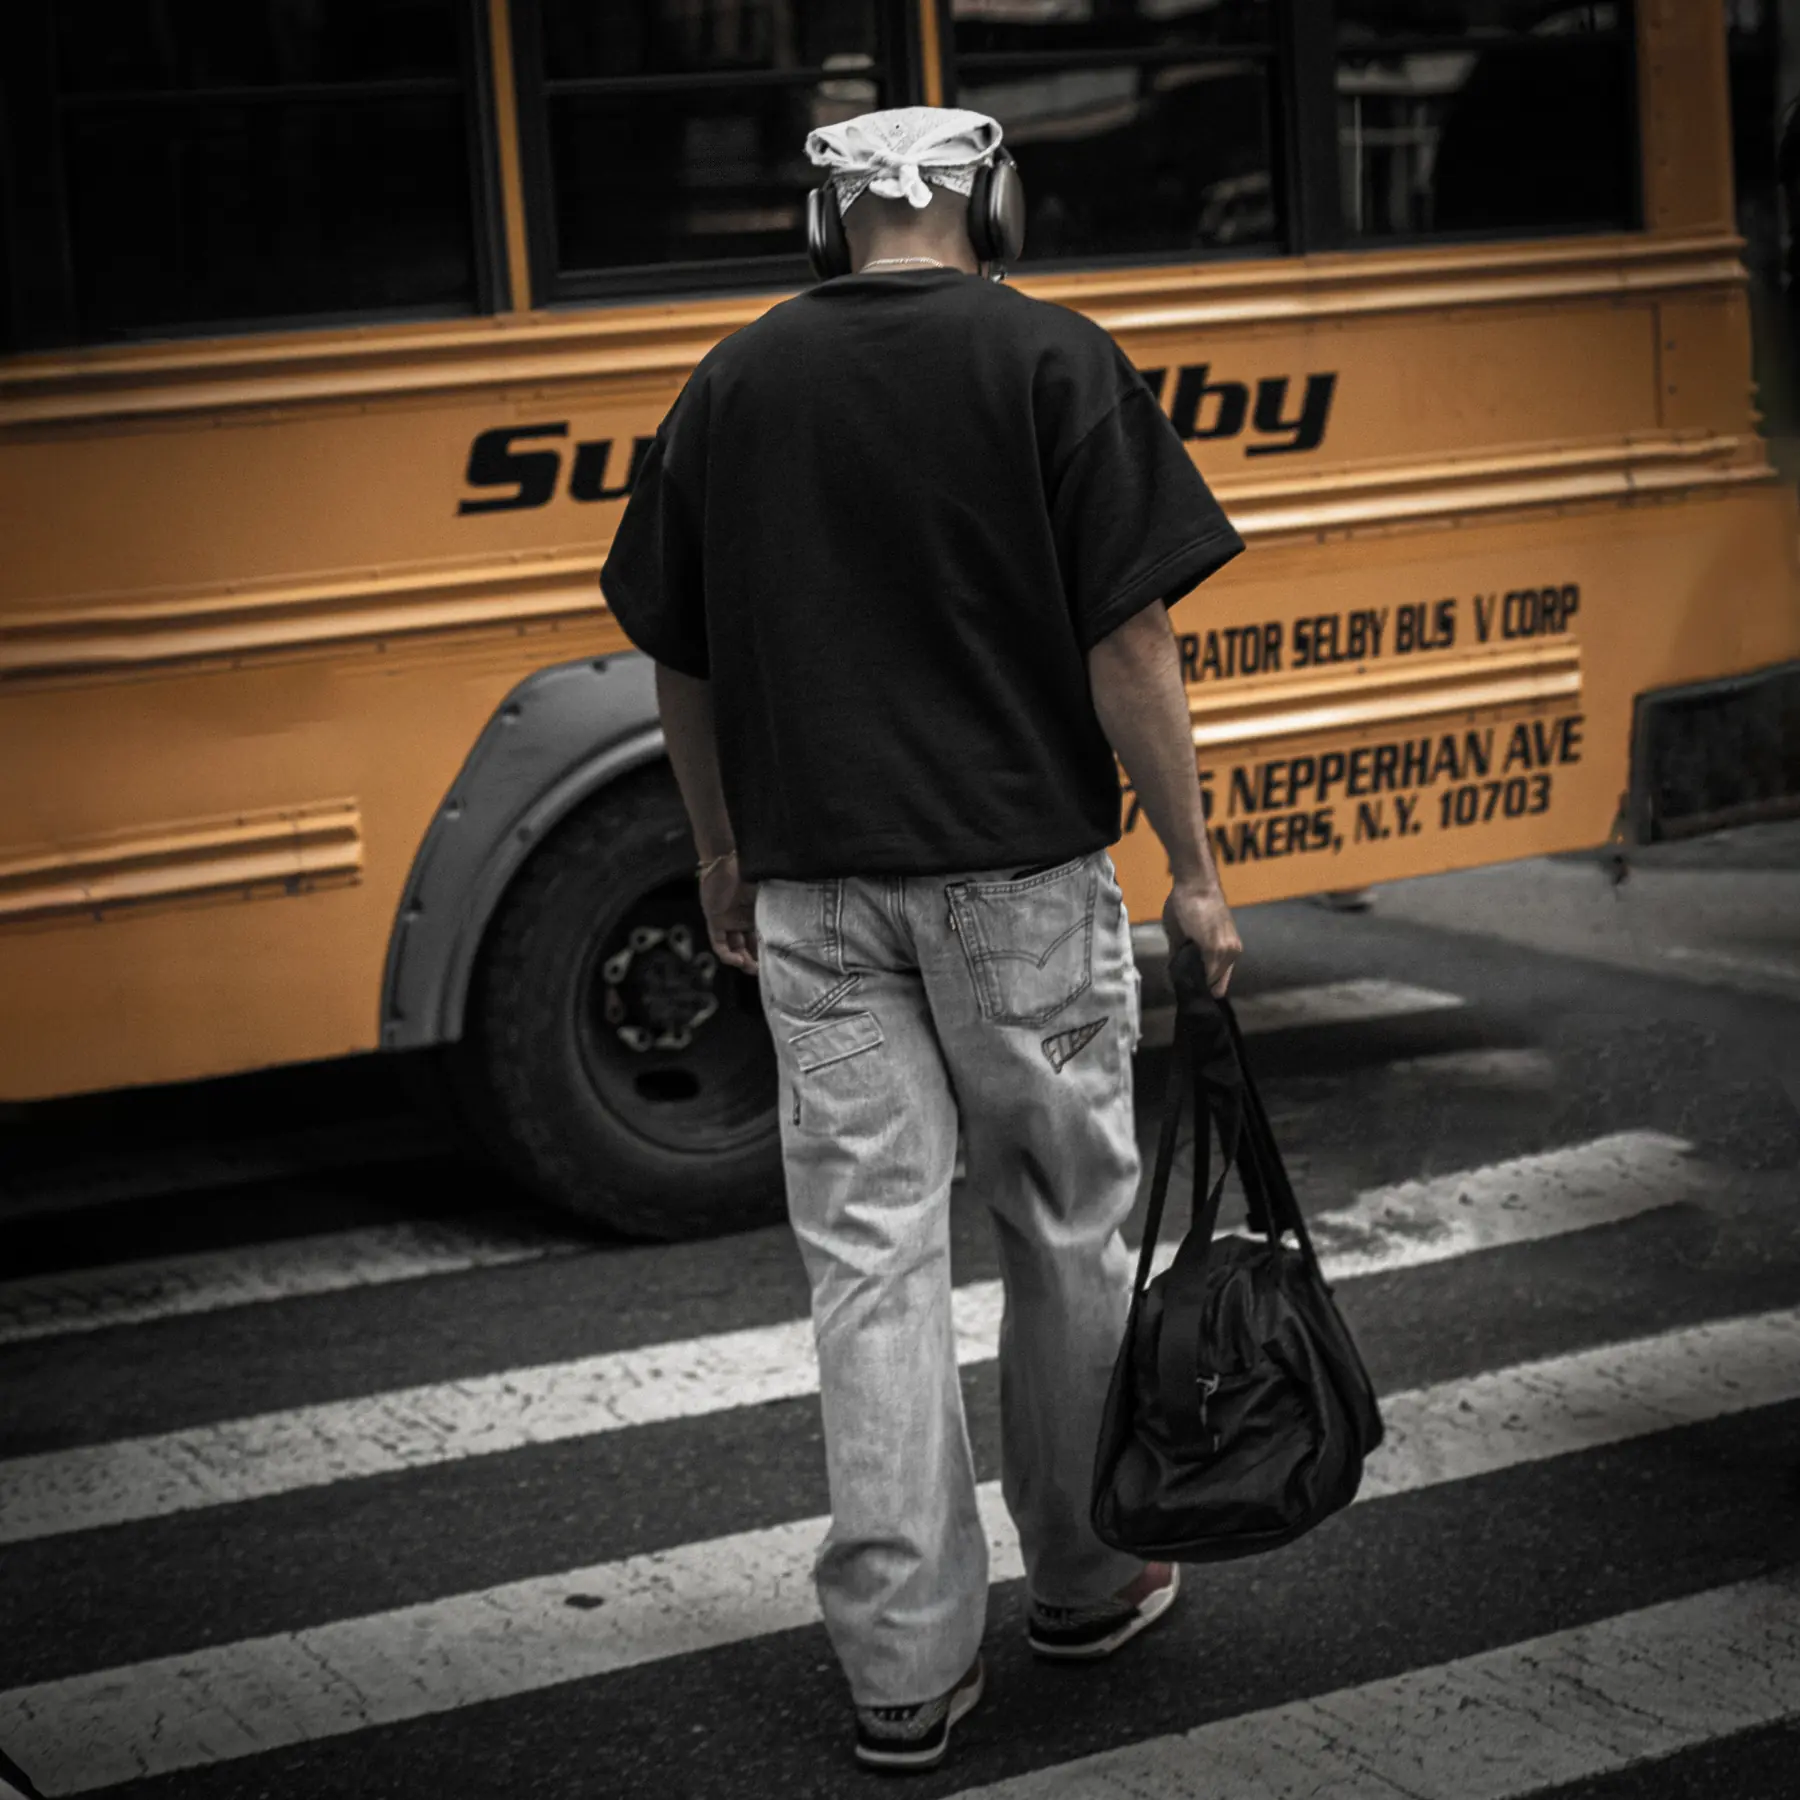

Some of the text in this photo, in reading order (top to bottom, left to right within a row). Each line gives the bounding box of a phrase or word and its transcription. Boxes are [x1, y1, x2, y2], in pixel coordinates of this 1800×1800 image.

[1137, 363, 1337, 457] by
[1291, 607, 1389, 668] SELBY
[1502, 583, 1581, 640] CORP
[1227, 726, 1495, 818] NEPPERHAN
[1502, 714, 1586, 774] AVE
[1354, 795, 1423, 845] N.Y.
[1438, 773, 1552, 830] 10703
